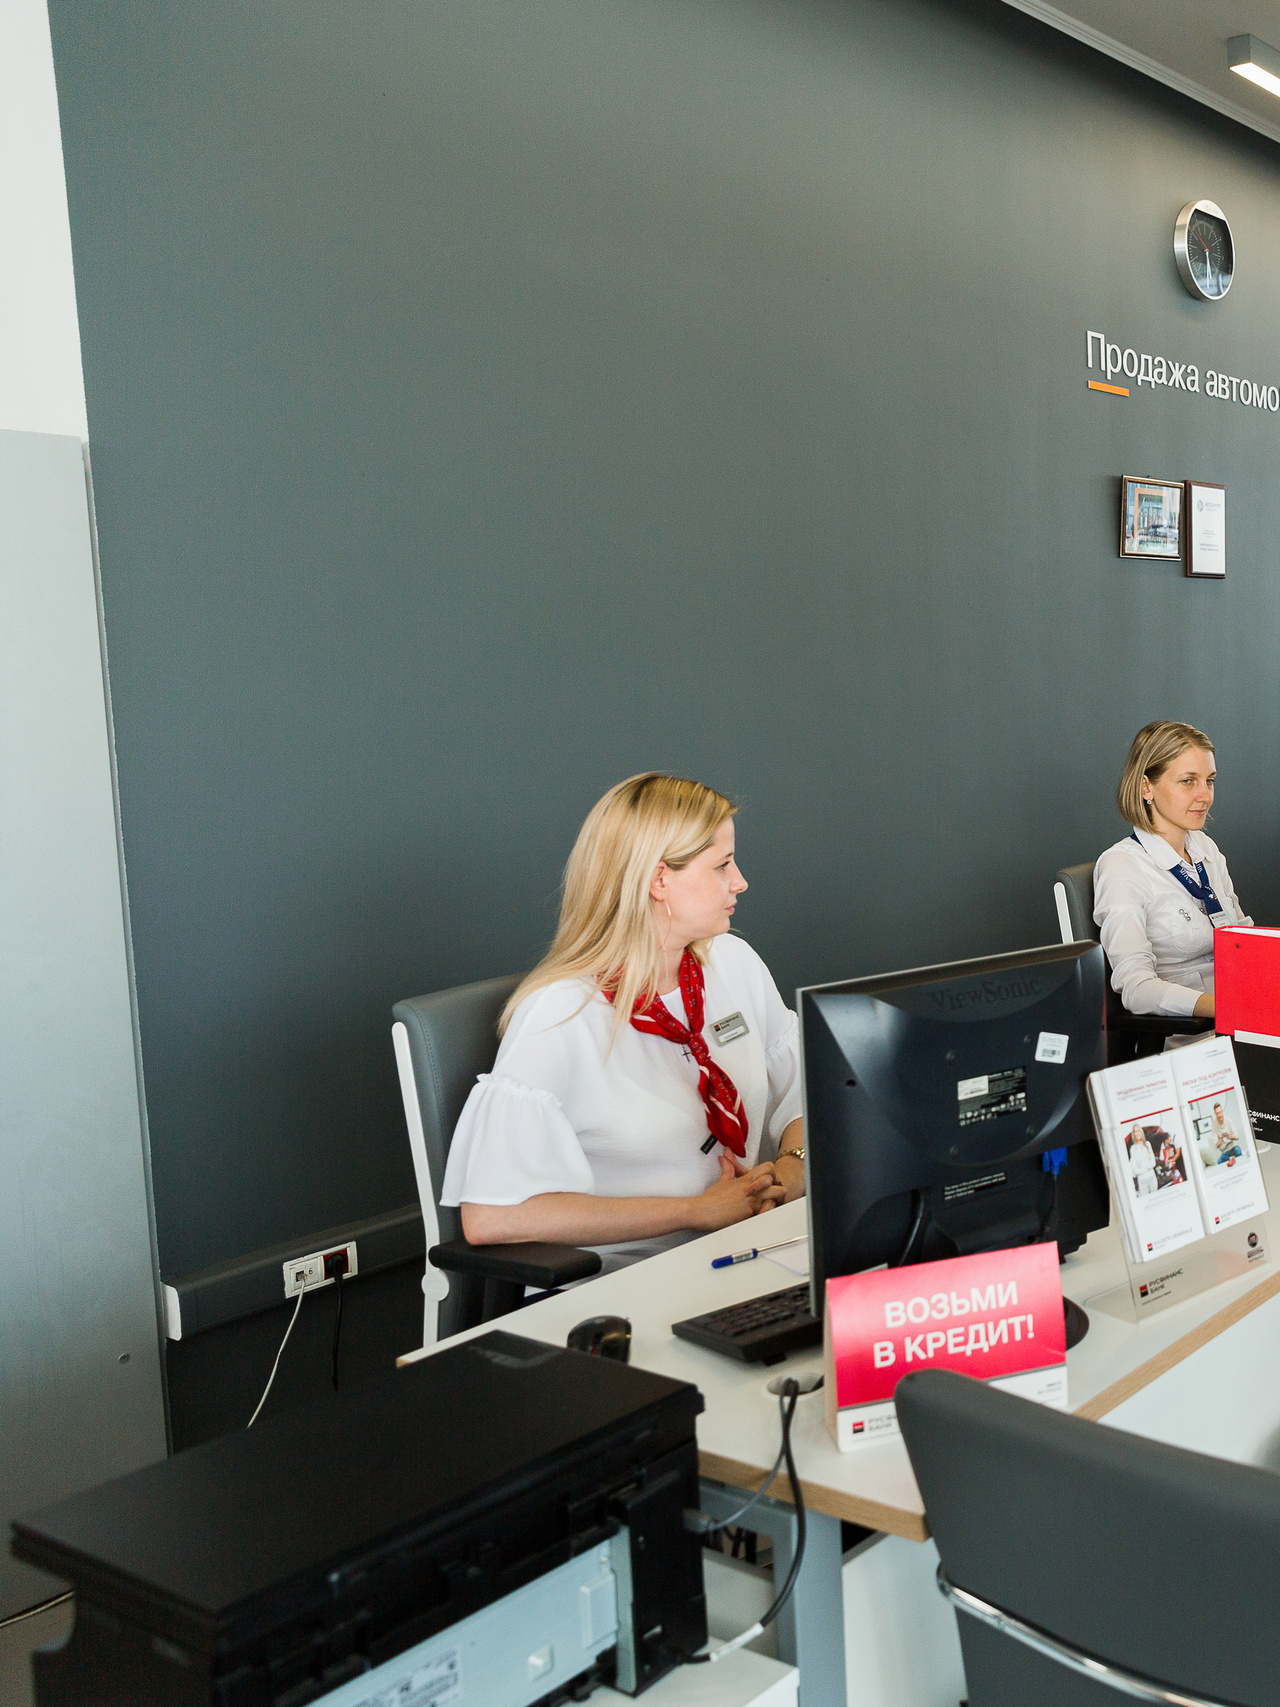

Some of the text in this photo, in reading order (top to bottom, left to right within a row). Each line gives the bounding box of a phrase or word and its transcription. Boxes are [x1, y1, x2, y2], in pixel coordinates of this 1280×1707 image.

[1086, 330, 1200, 393] Продажа
[928, 974, 1041, 1010] ViewSonic
[1249, 1109, 1280, 1122] СФИНАНС
[308, 1267, 314, 1275] 6
[883, 1280, 1019, 1329] ВОЗЬМИ
[873, 1313, 1036, 1369] В КРЕДИТ!
